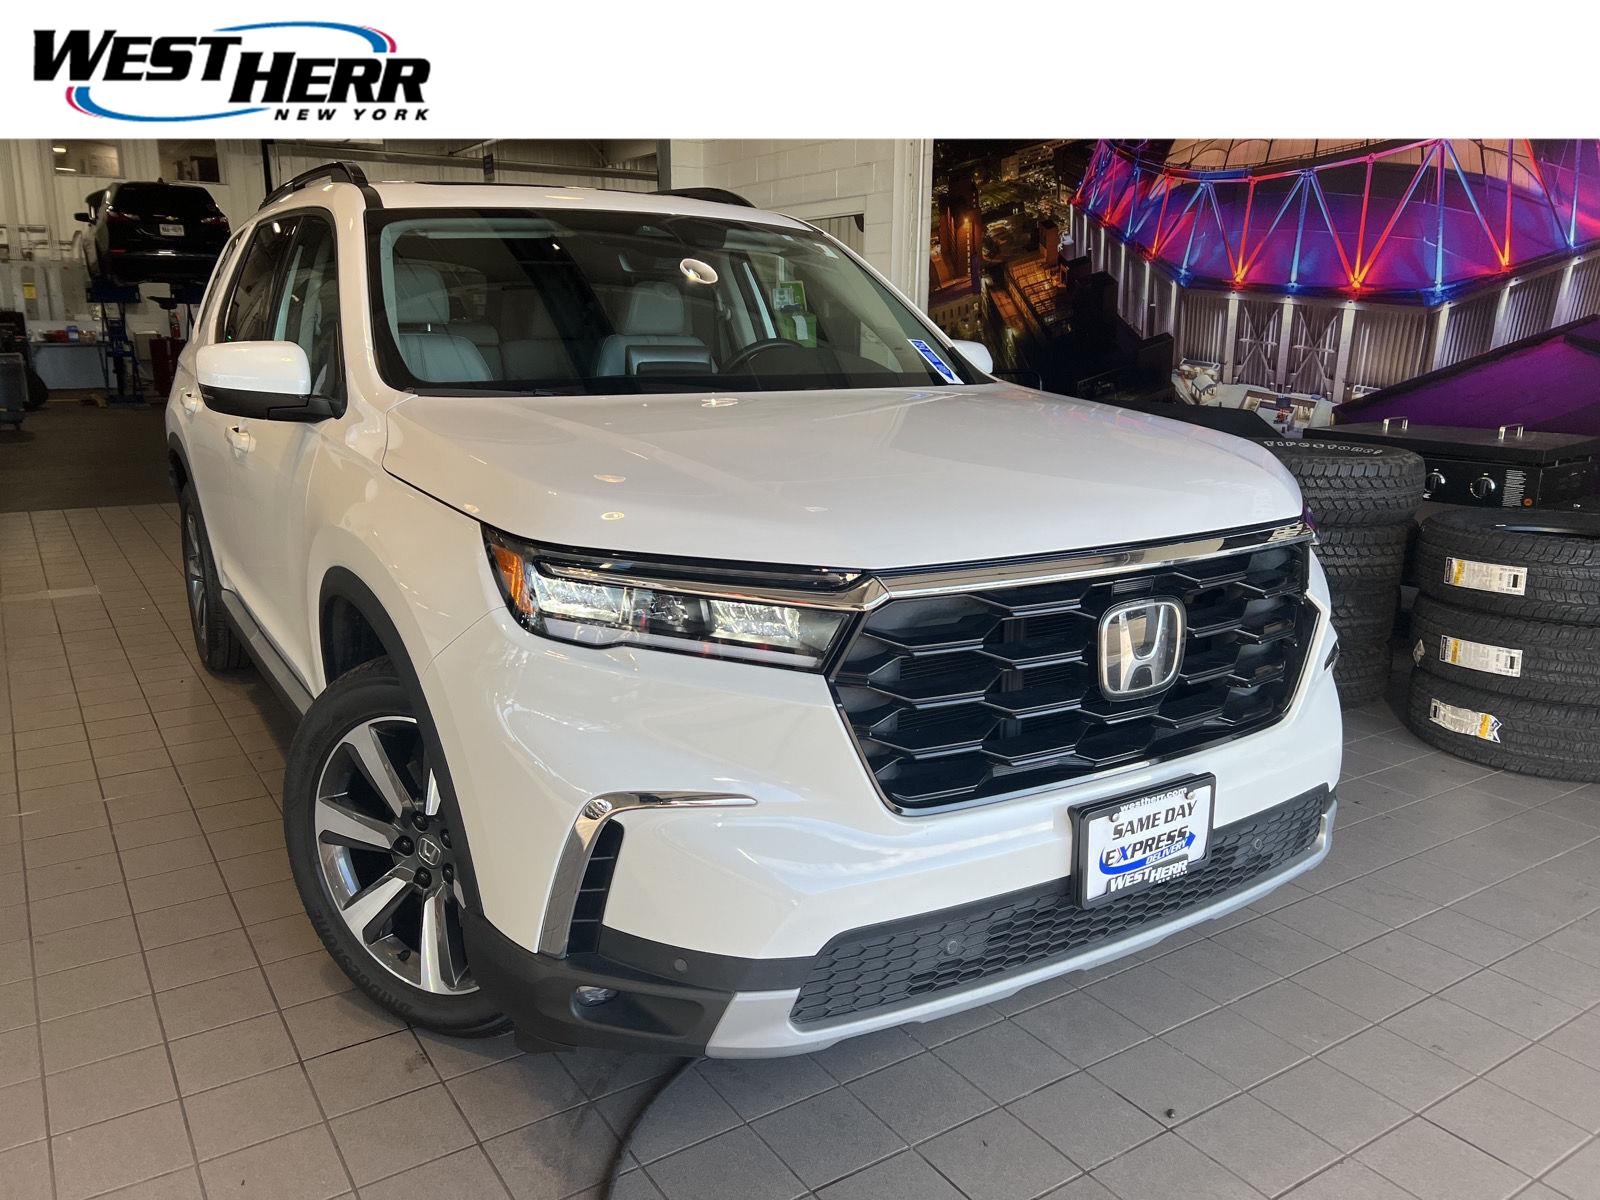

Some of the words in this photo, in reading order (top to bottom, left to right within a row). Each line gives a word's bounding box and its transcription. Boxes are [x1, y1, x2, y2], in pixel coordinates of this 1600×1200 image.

[1120, 787, 1187, 812] westherr.com
[1112, 812, 1161, 841] SAME
[1163, 800, 1197, 824] DAY
[1105, 825, 1189, 867] EXPRESS
